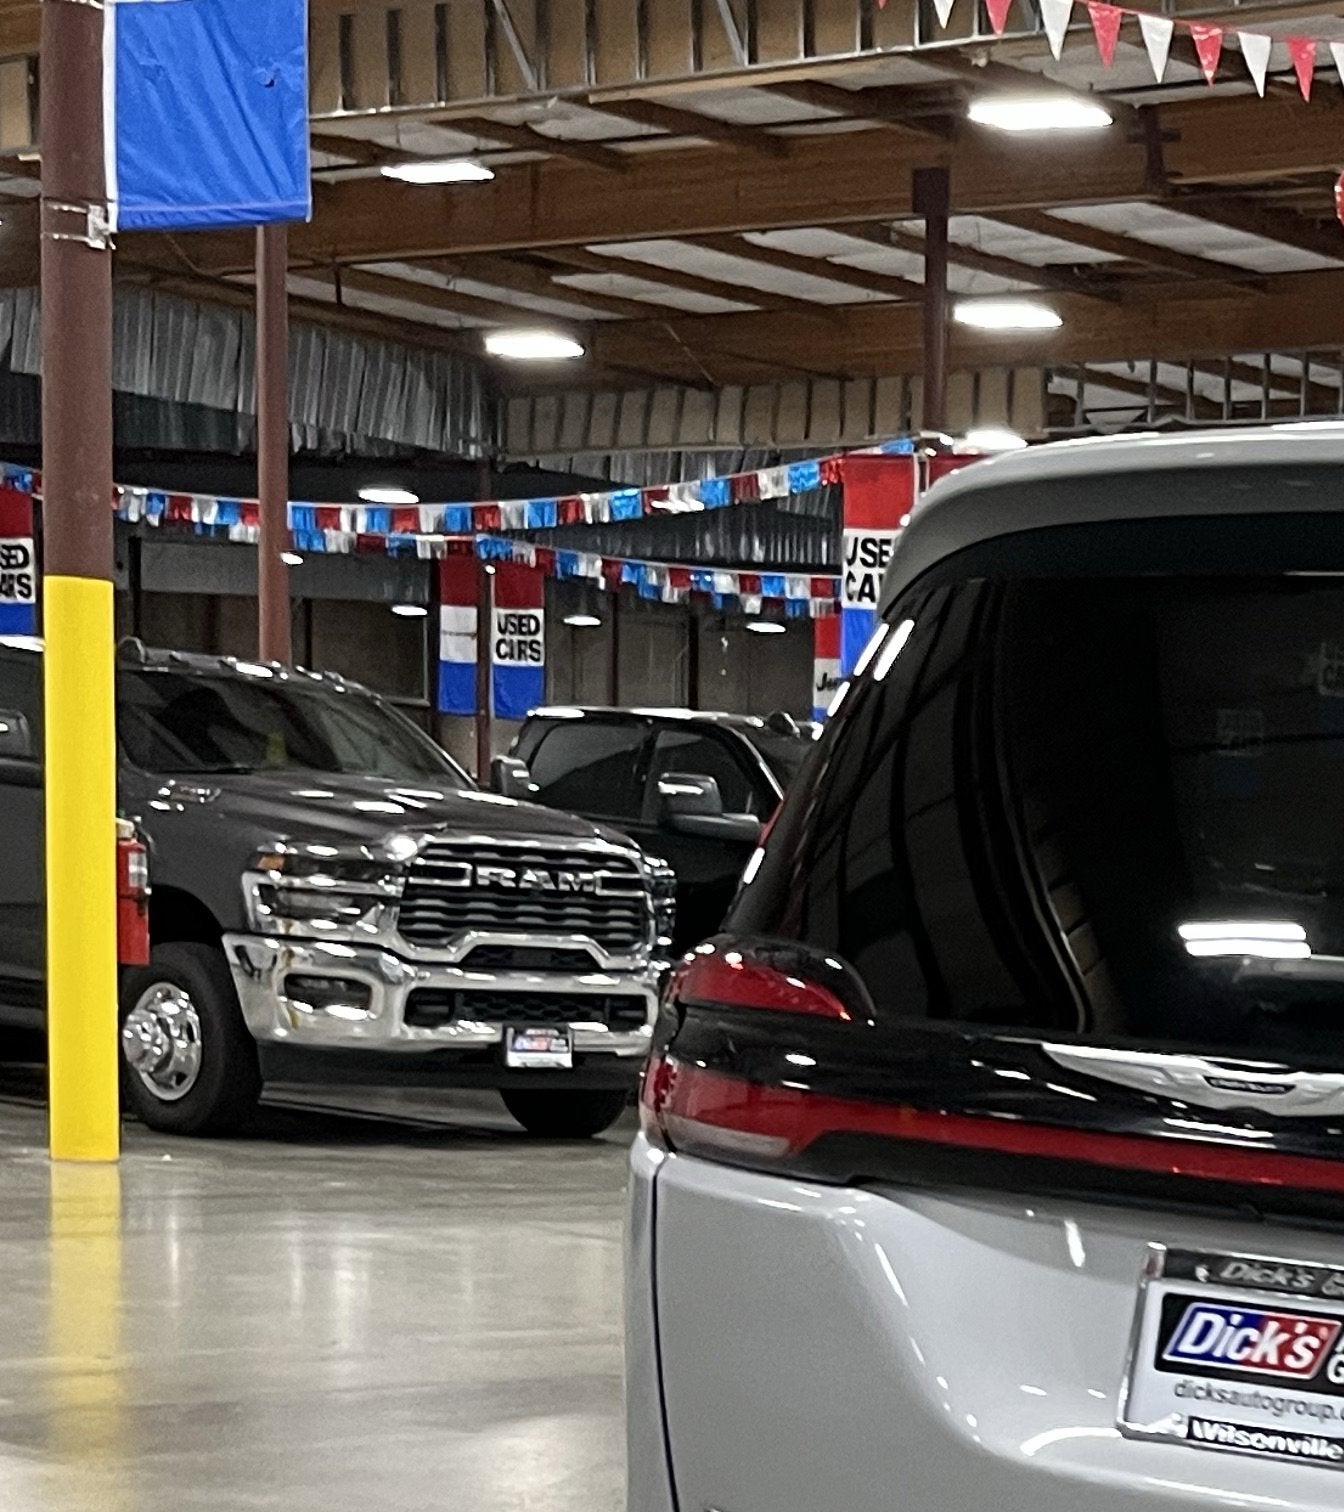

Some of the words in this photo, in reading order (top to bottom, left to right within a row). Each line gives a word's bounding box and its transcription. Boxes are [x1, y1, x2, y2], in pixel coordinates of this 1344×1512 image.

[0, 543, 30, 570] SED
[497, 613, 541, 636] USED
[476, 866, 594, 892] RAM
[1177, 1311, 1321, 1371] Dick's
[1191, 1419, 1344, 1462] Wilsonville
